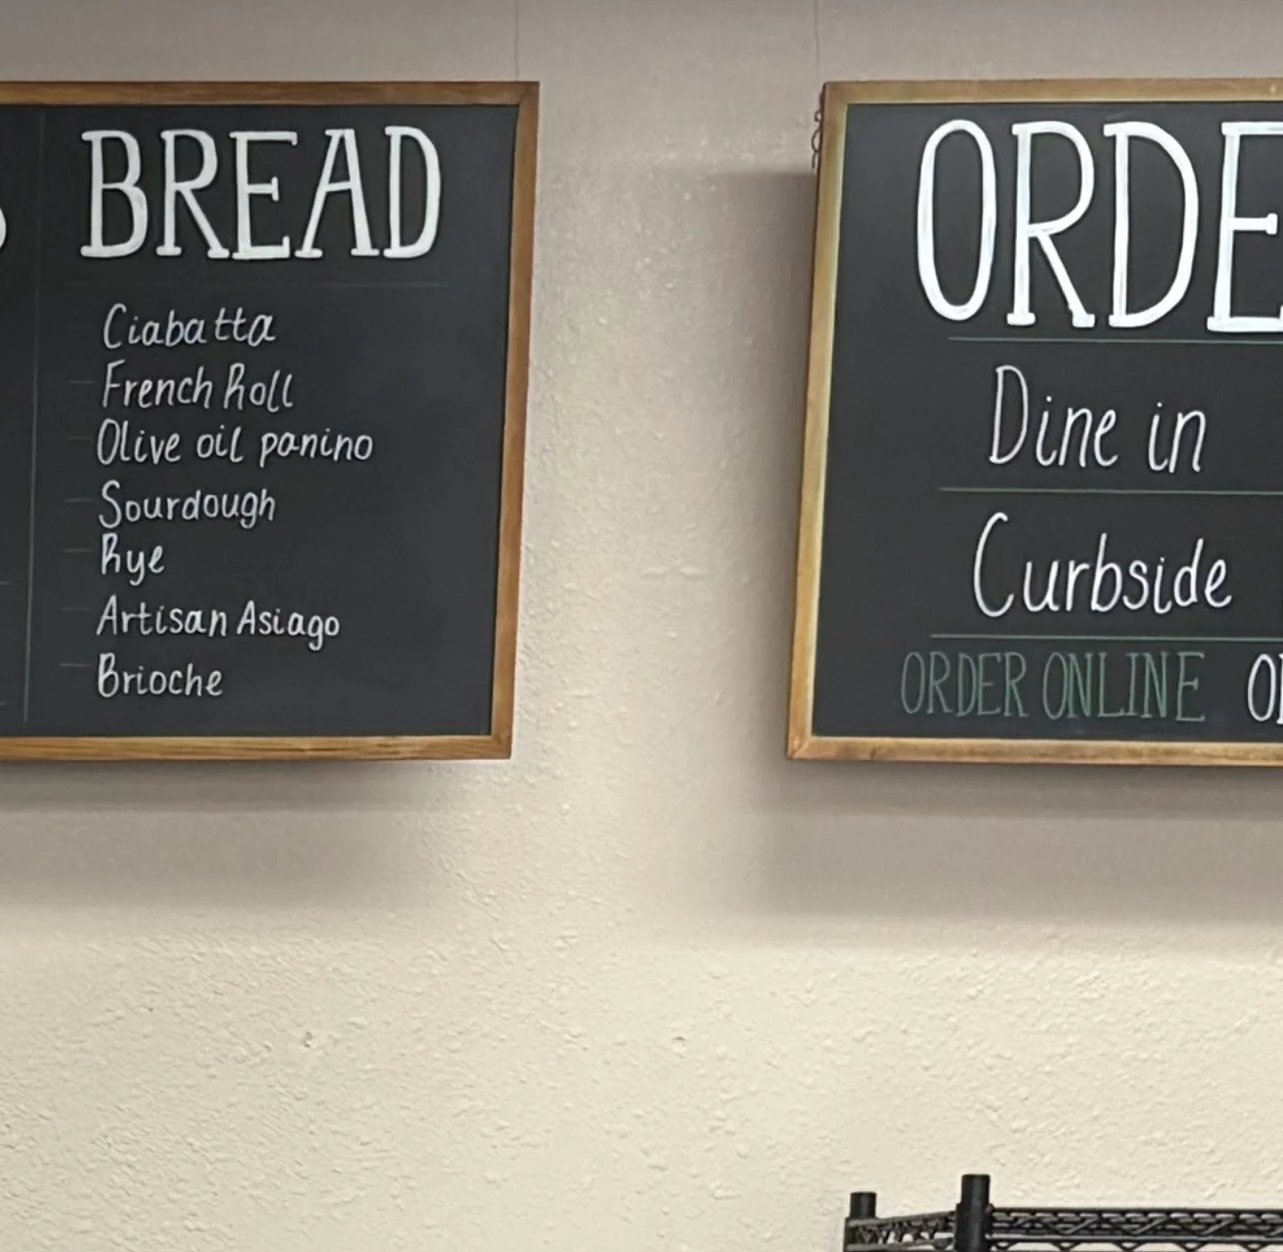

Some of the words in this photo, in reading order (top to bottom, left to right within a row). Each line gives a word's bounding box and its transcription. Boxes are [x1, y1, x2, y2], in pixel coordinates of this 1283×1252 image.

[81, 126, 441, 260] BREAD
[916, 119, 1283, 332] ORDE
[104, 303, 275, 348] Ciabatta
[102, 360, 214, 409] French
[224, 364, 293, 412] Roll
[97, 424, 180, 464] Olive
[197, 425, 243, 462] oil
[260, 428, 372, 467] panino
[989, 365, 1117, 467] Dine
[1149, 402, 1205, 473] in
[99, 480, 275, 528] Sourdough
[101, 532, 166, 586] Rye
[974, 512, 1231, 617] Curbside
[96, 595, 226, 636] Artisan
[237, 600, 339, 650] Asiago
[98, 654, 222, 697] Brioche
[901, 651, 1028, 717] ORDER
[1043, 651, 1205, 722] ONLINE
[1248, 653, 1283, 724] O
